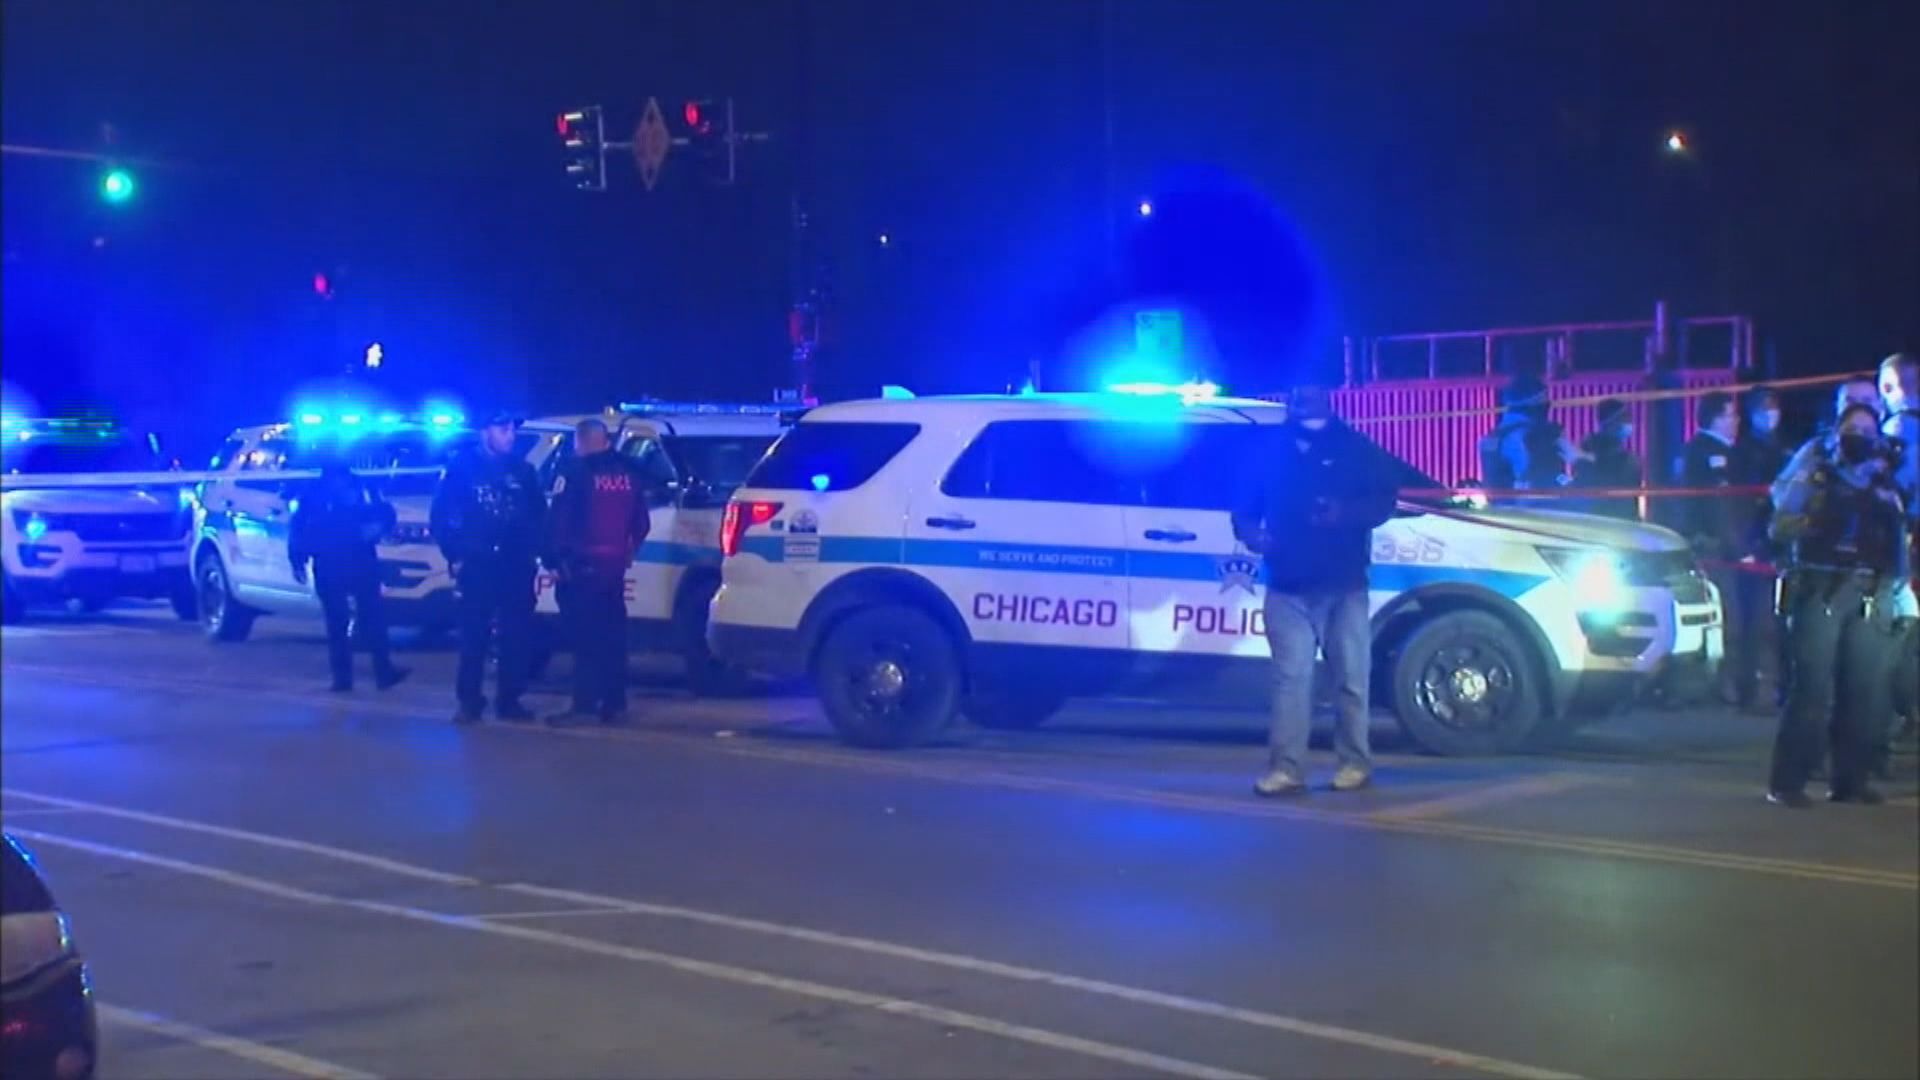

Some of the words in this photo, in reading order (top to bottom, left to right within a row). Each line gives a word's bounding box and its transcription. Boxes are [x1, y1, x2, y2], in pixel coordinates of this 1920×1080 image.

[593, 473, 633, 490] POLICE
[1037, 553, 1060, 565] AND
[972, 593, 1118, 627] CHICAGO
[1173, 604, 1266, 636] POLIC
